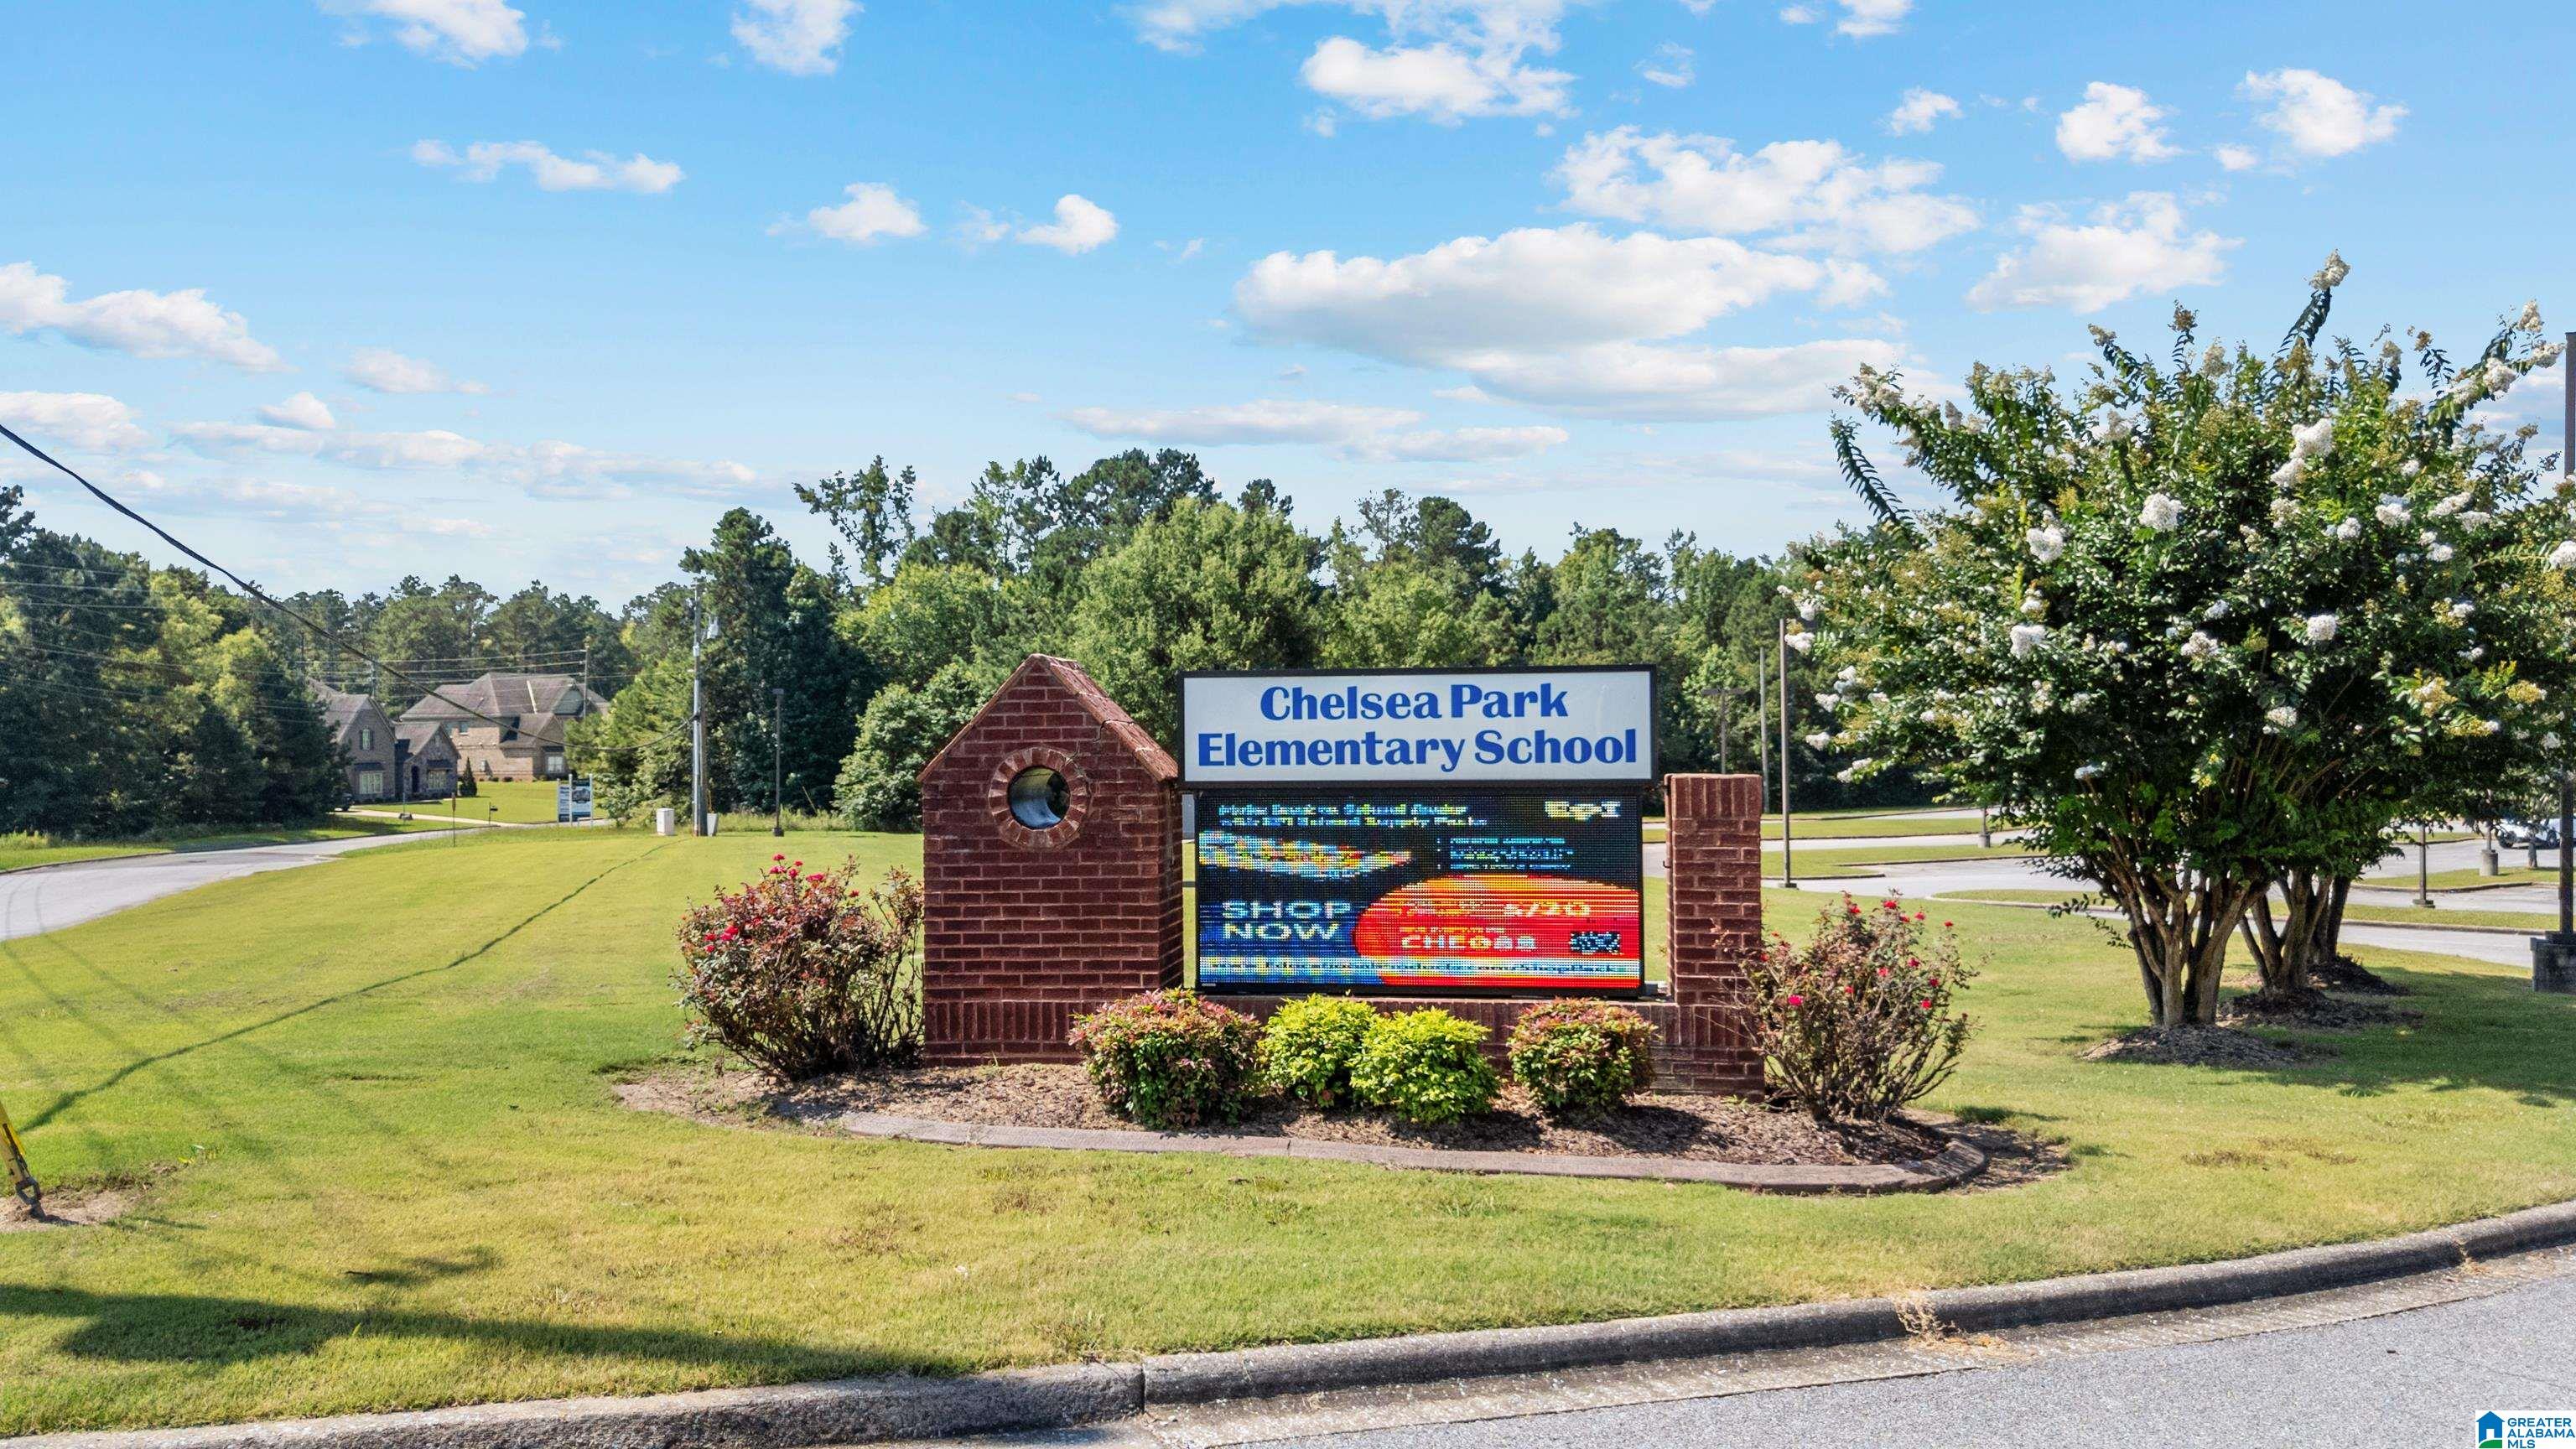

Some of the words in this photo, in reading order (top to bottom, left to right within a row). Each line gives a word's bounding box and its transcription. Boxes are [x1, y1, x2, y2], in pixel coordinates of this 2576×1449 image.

[1260, 684, 1441, 721] Chelsea
[1450, 682, 1569, 719] Park
[1197, 730, 1466, 773] Elementary
[1474, 727, 1637, 765] School
[1222, 900, 1351, 919] SHOP
[1223, 922, 1341, 940] NOW
